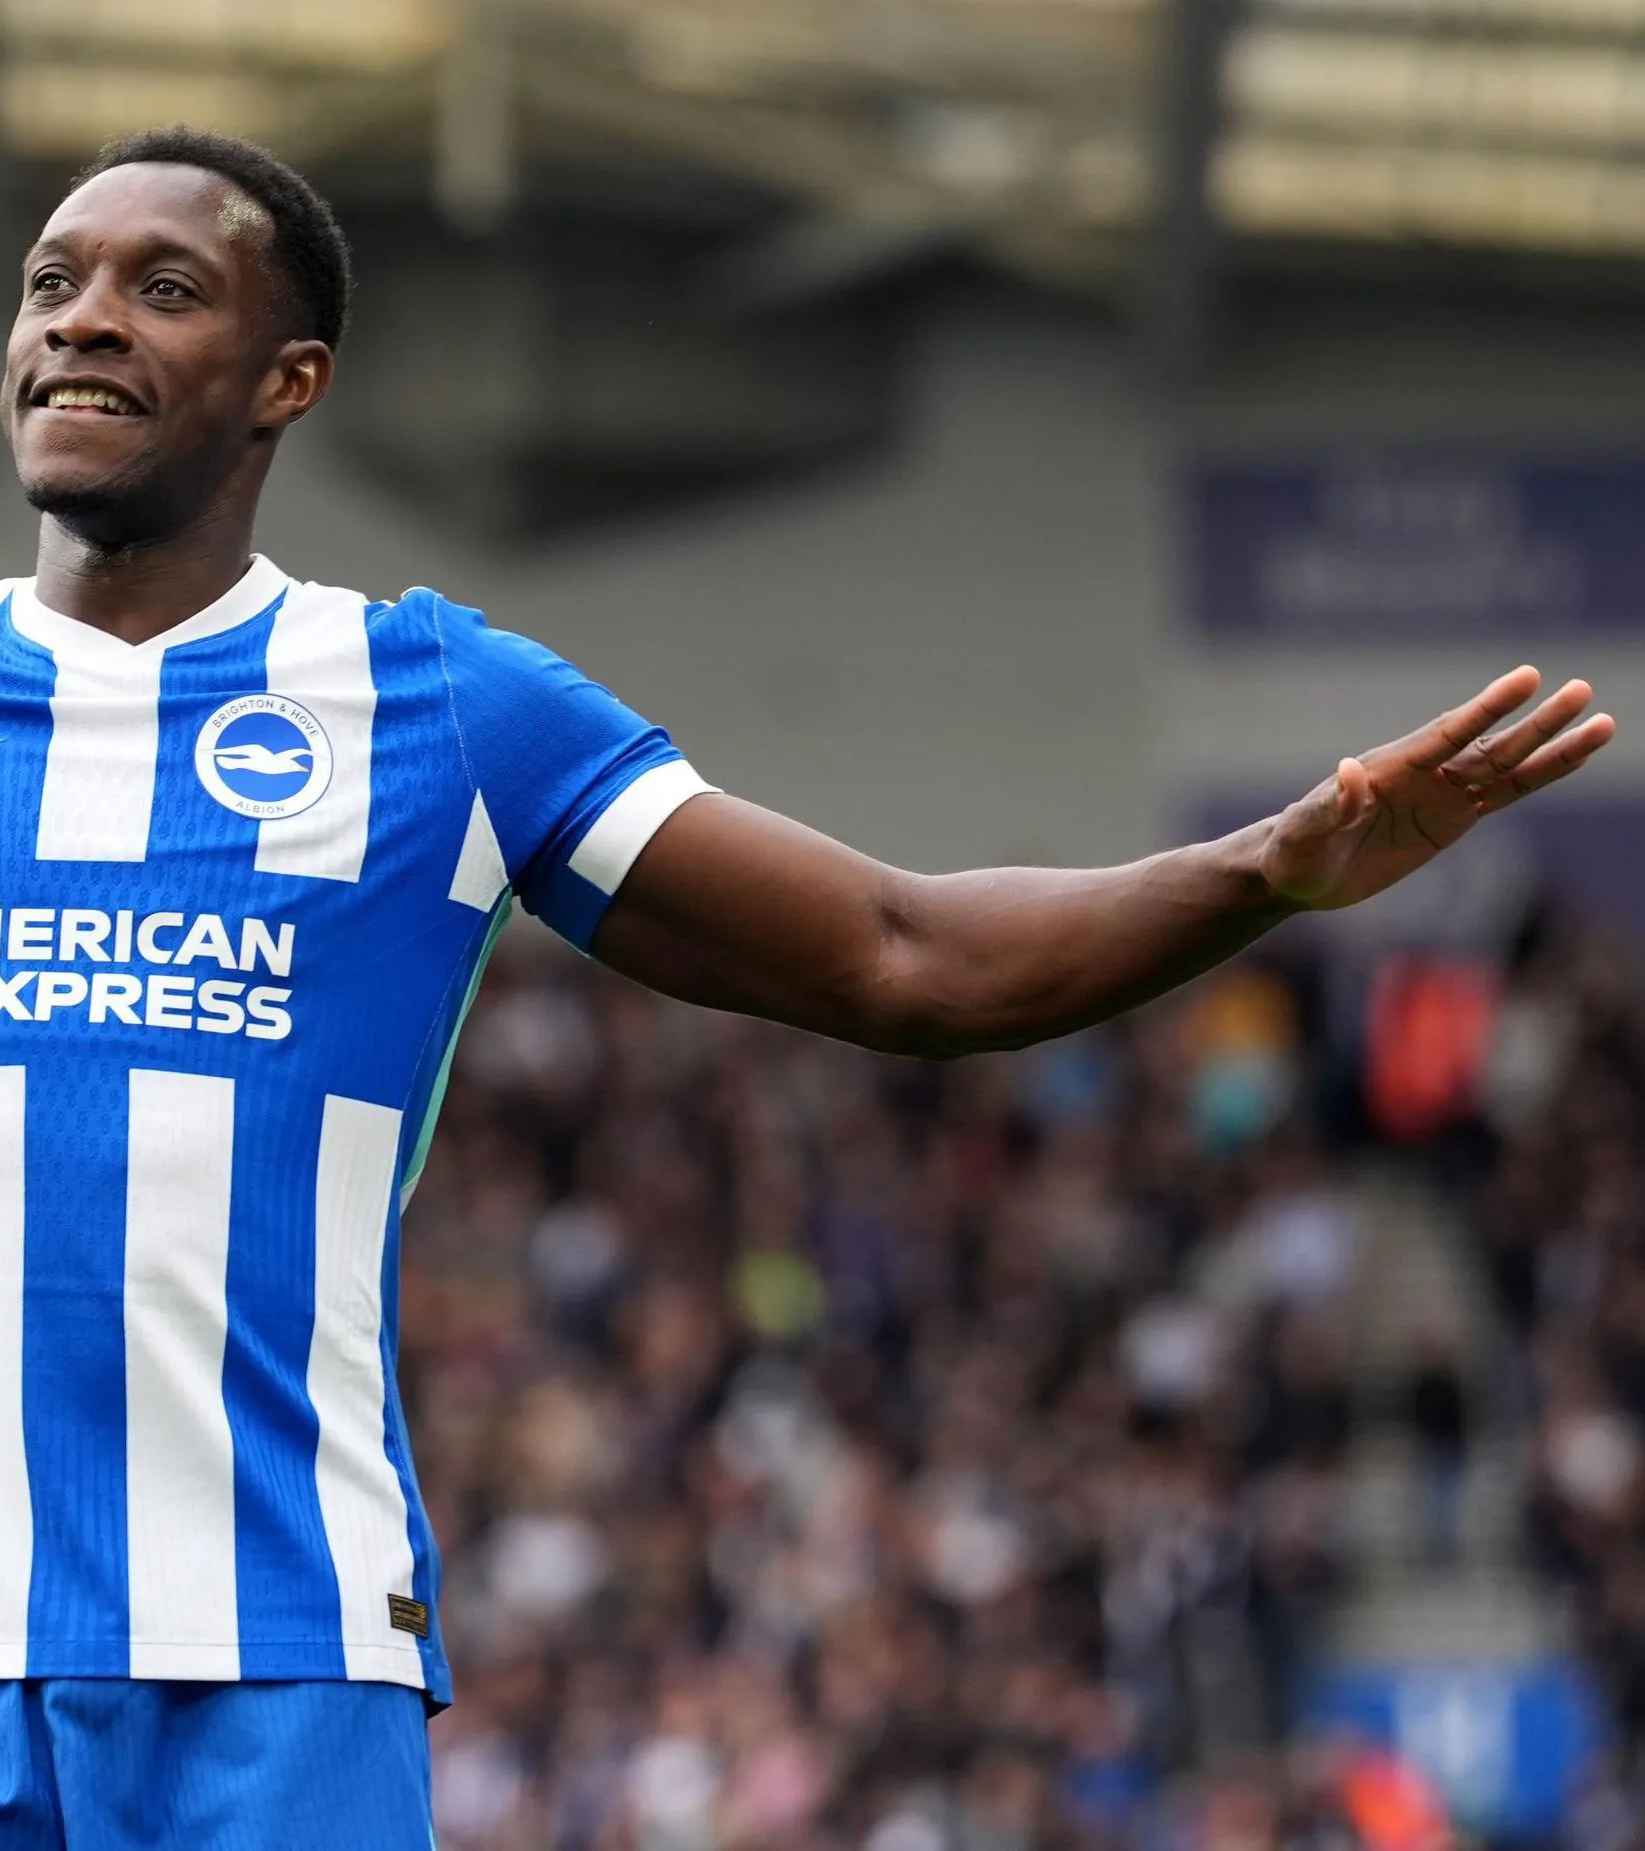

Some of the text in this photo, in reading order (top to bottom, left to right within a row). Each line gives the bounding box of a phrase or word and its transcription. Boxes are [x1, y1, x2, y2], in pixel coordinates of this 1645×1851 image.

[212, 699, 320, 737] BRIGHTON & HOVE
[236, 801, 285, 815] ALBION
